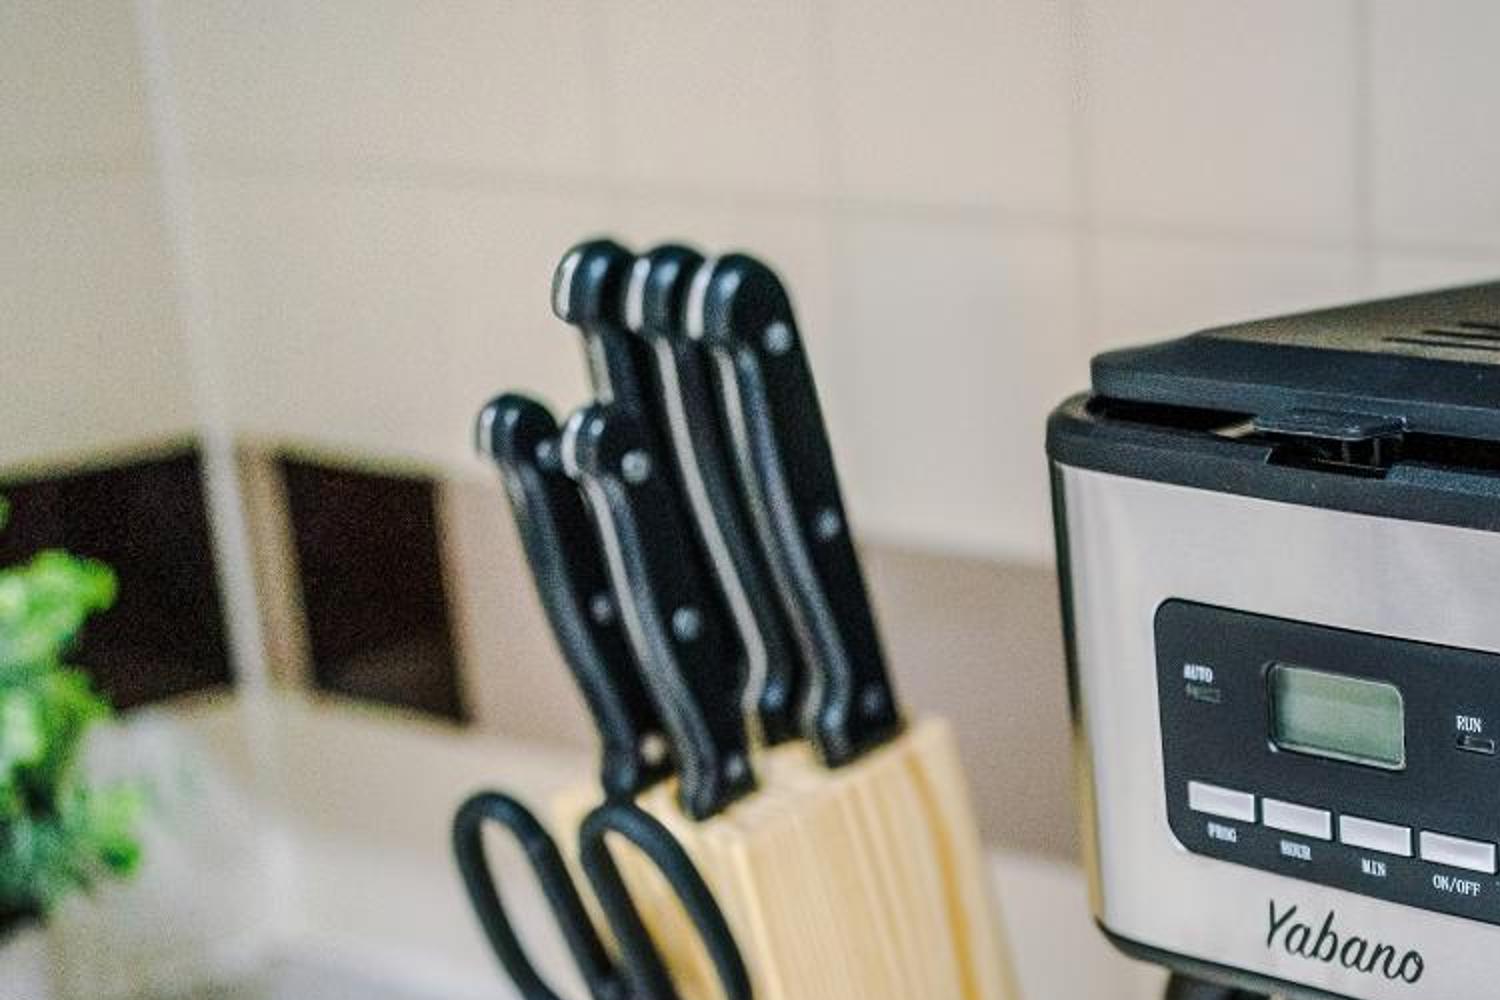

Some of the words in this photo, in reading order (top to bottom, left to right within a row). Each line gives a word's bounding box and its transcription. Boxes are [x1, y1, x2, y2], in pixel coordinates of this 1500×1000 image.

[1184, 664, 1213, 683] AUTO
[1456, 715, 1482, 732] RUN
[1362, 858, 1386, 877] MIN
[1432, 874, 1480, 896] ON/OFF
[1265, 899, 1424, 983] Yabano
